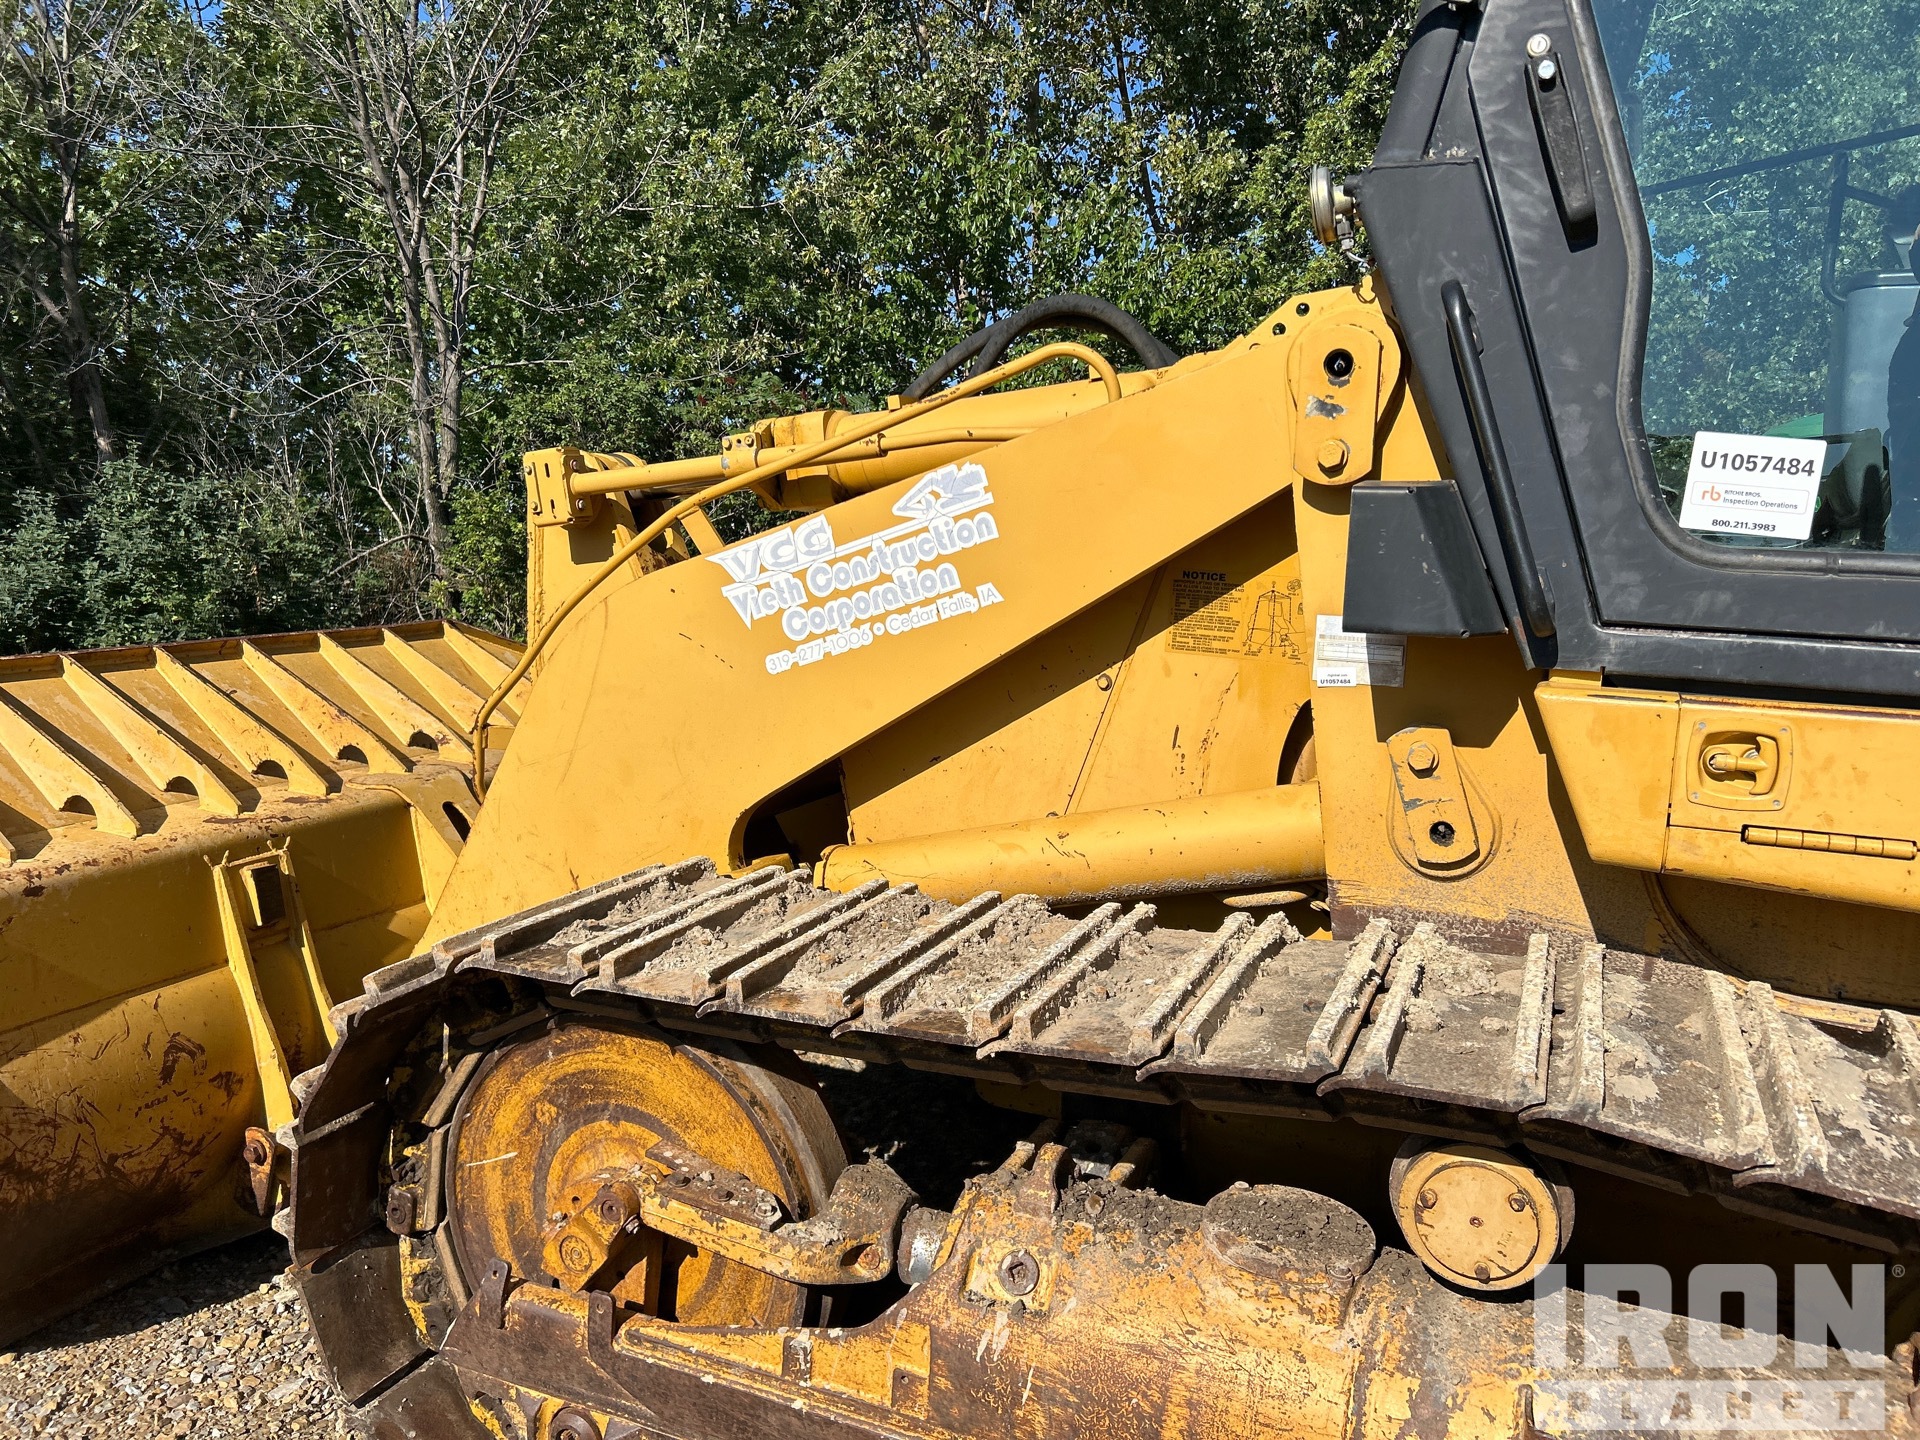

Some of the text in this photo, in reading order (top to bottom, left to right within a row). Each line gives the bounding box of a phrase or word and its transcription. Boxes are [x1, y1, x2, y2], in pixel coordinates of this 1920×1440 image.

[1700, 450, 1816, 478] U1057484
[1701, 485, 1722, 502] rb
[1723, 497, 1799, 510] Inspection Operations
[1711, 518, 1777, 532] 800.211.3983
[713, 516, 834, 582] VCC
[726, 513, 997, 622] Vieth Construction
[1182, 570, 1226, 581] NOTICE
[783, 565, 959, 639] Corporation
[768, 587, 999, 672] 319-277-1006 Cedar Falls, IA
